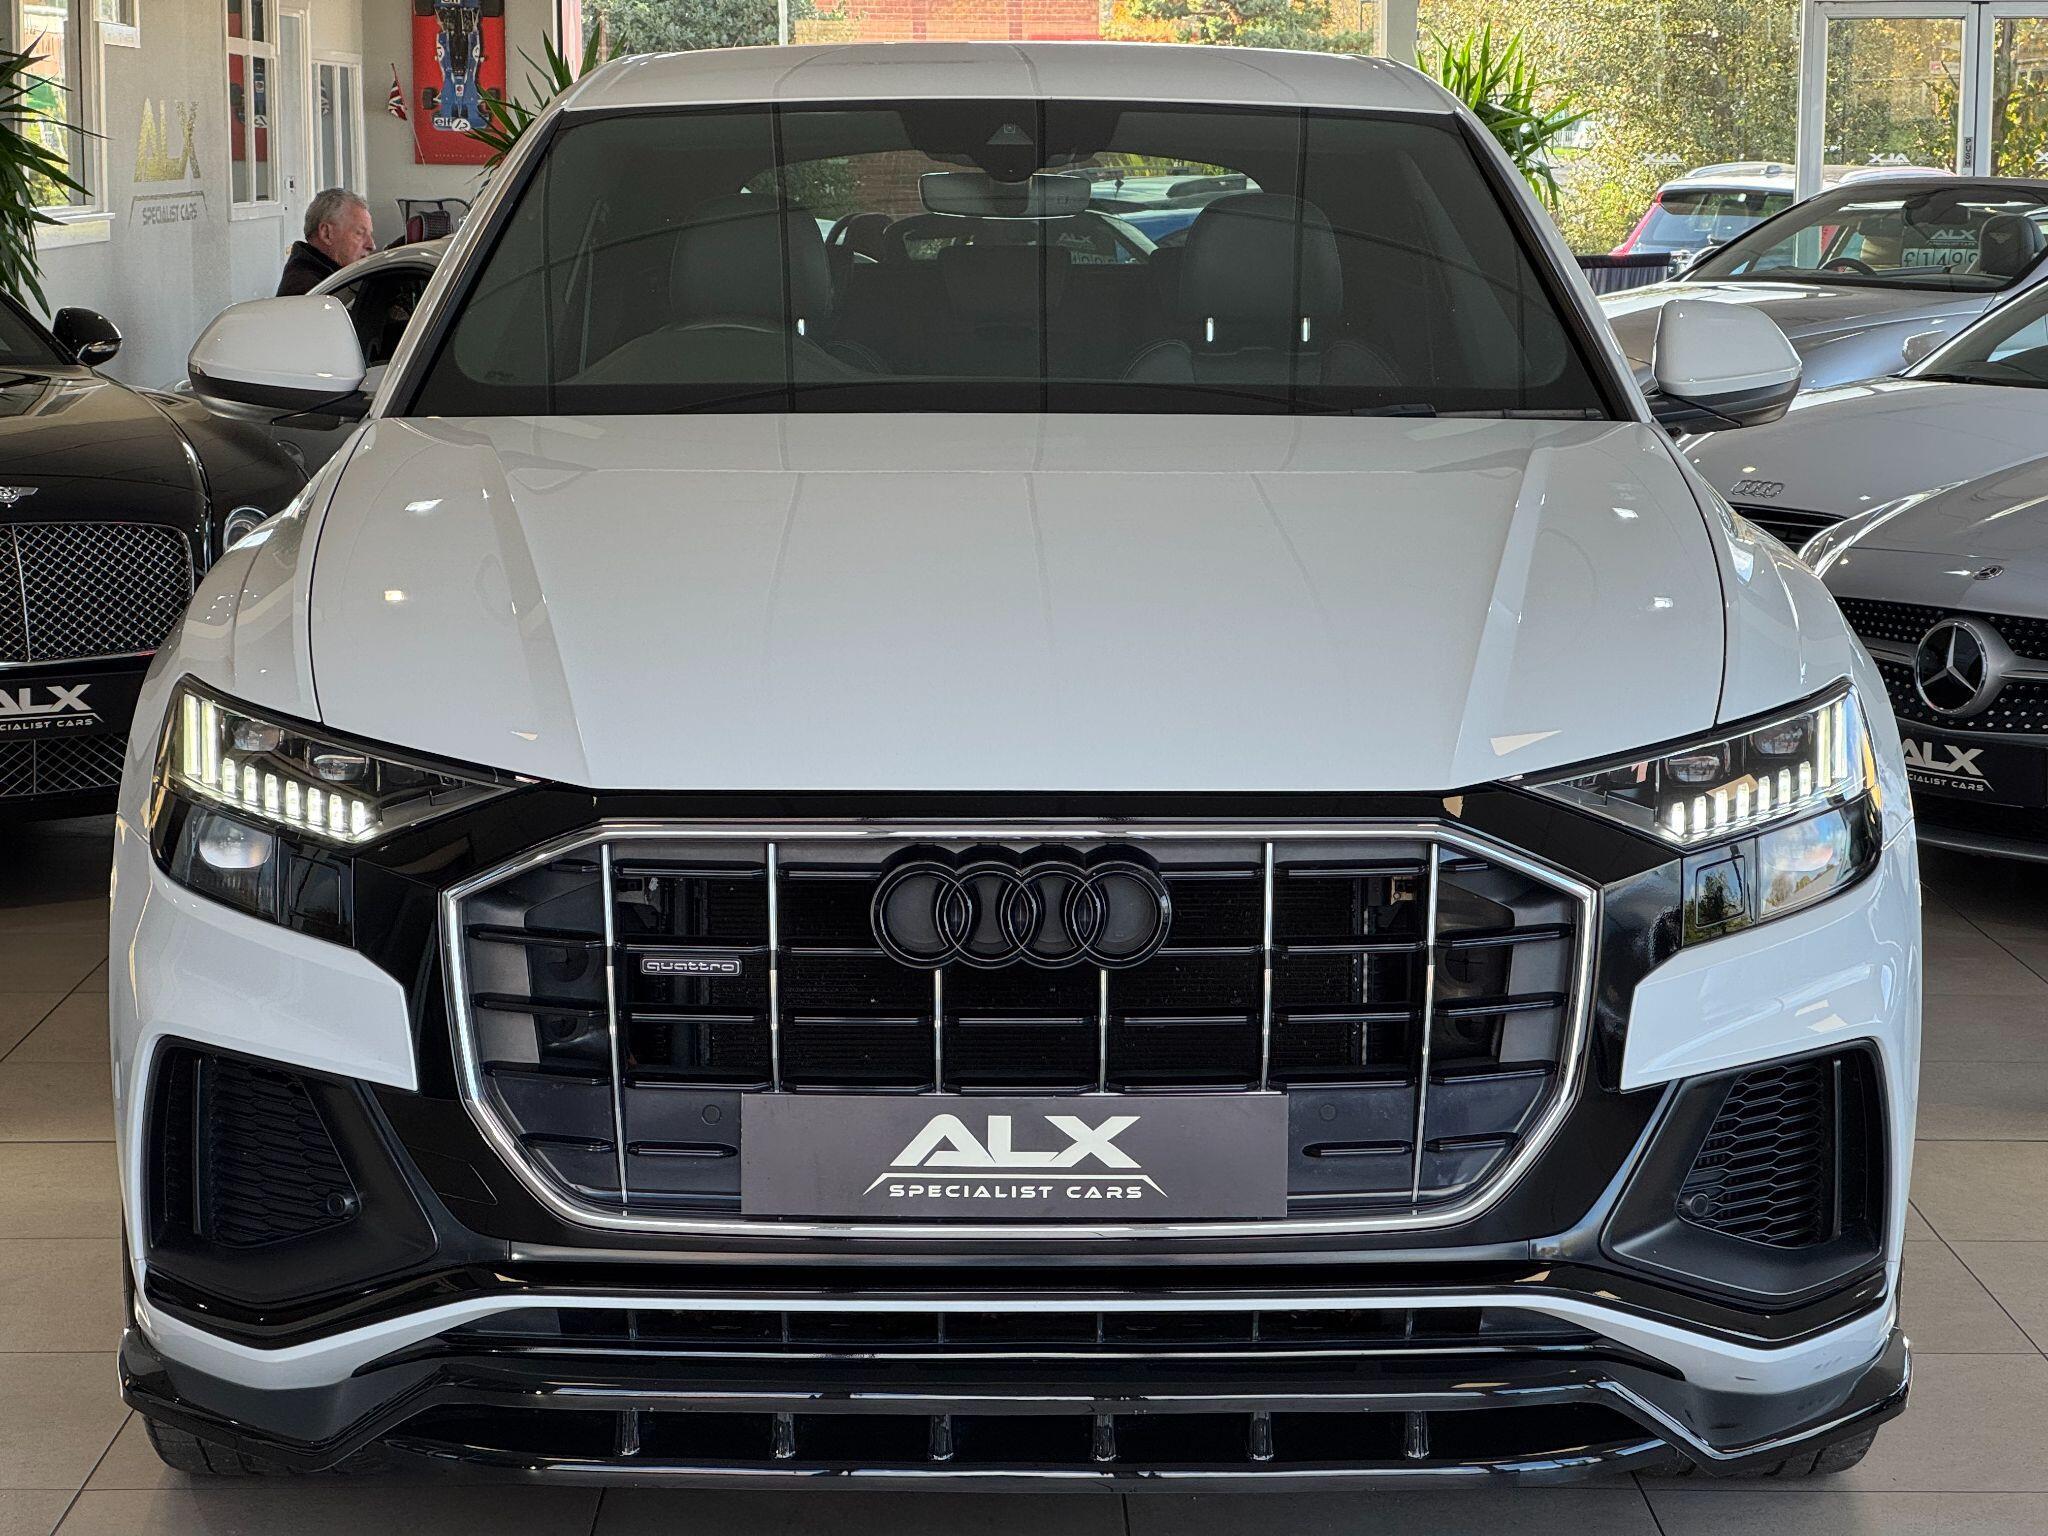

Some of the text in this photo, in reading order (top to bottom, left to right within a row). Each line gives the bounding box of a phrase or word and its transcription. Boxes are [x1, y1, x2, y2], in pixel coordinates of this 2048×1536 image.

[133, 97, 200, 182] ALX
[1930, 229, 1976, 240] ALX
[0, 719, 93, 731] CIALIST CARS
[1902, 738, 1984, 776] ALX
[1907, 773, 1984, 791] CIALIST CARS
[647, 962, 734, 971] quattro
[889, 1114, 1142, 1168] ALX
[889, 1184, 1142, 1198] SPECIALIST CARS
